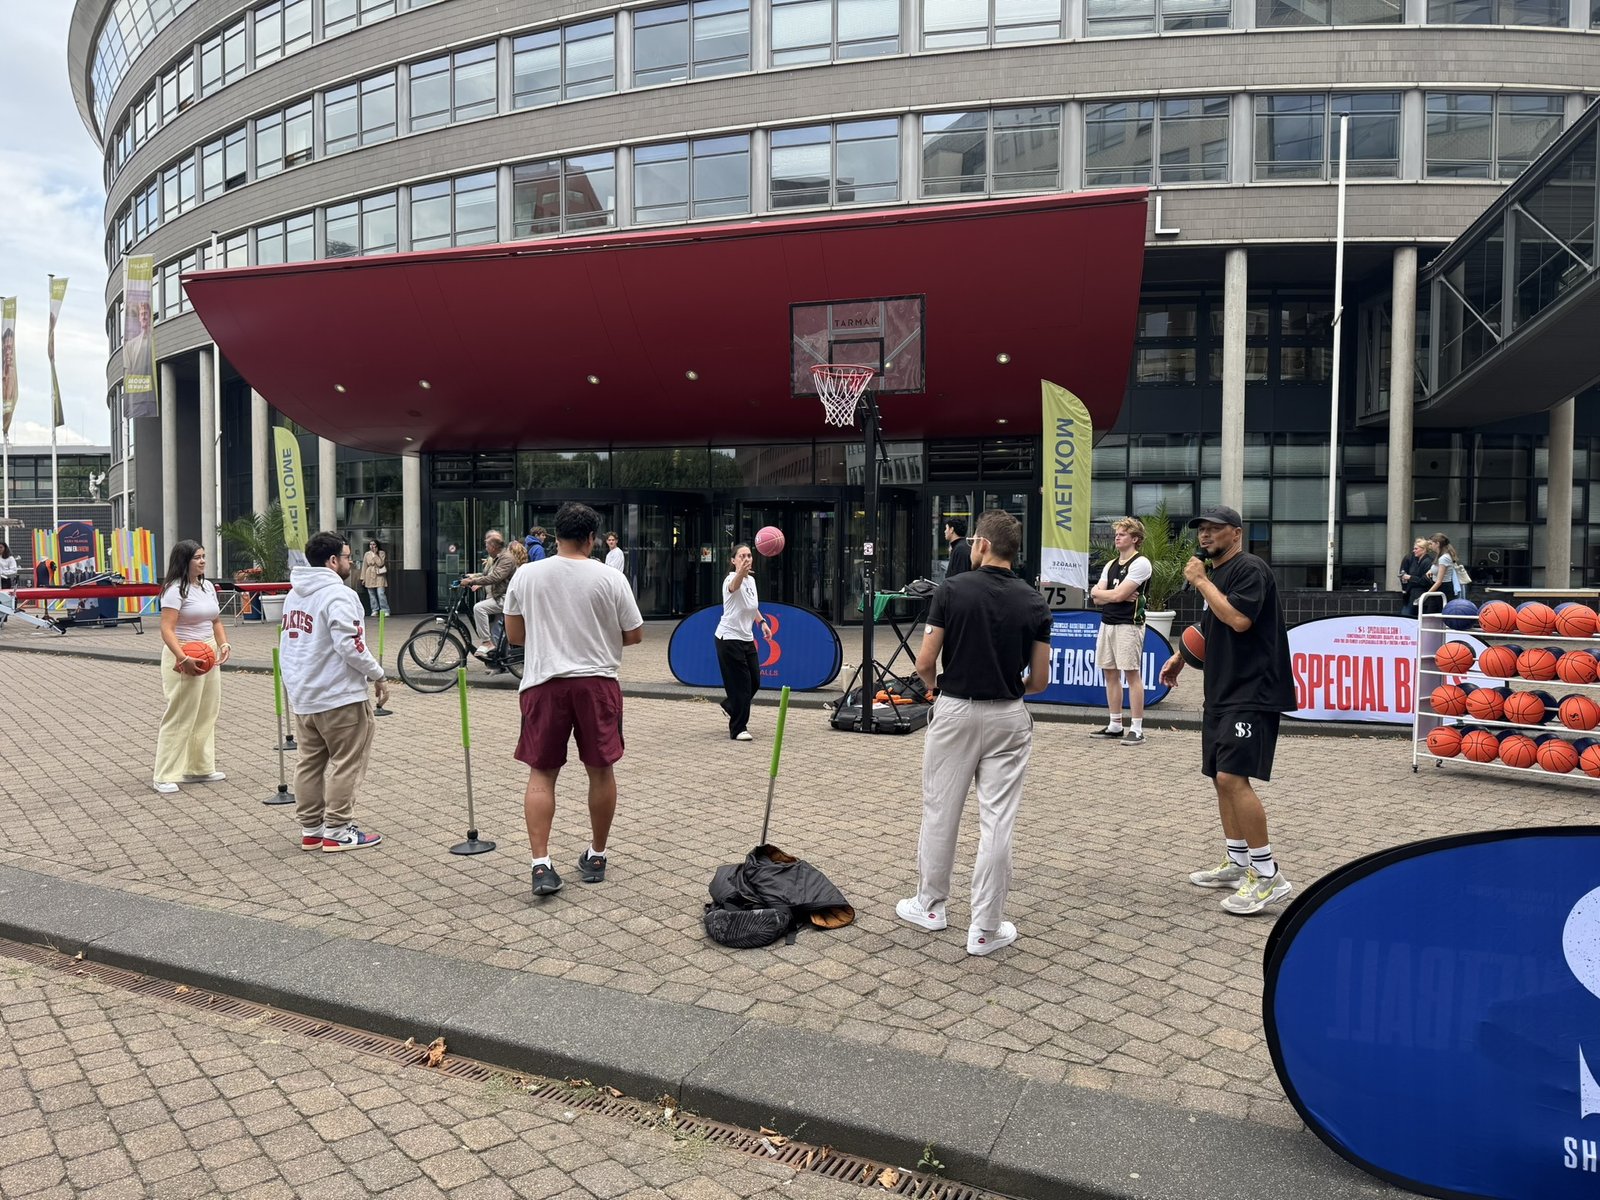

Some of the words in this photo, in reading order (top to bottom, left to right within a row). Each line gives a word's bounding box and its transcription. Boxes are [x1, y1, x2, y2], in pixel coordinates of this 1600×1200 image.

[834, 317, 877, 327] TARMAK
[1044, 587, 1067, 606] 75
[1292, 652, 1389, 713] SPECIAL
[1563, 1136, 1597, 1173] SH
